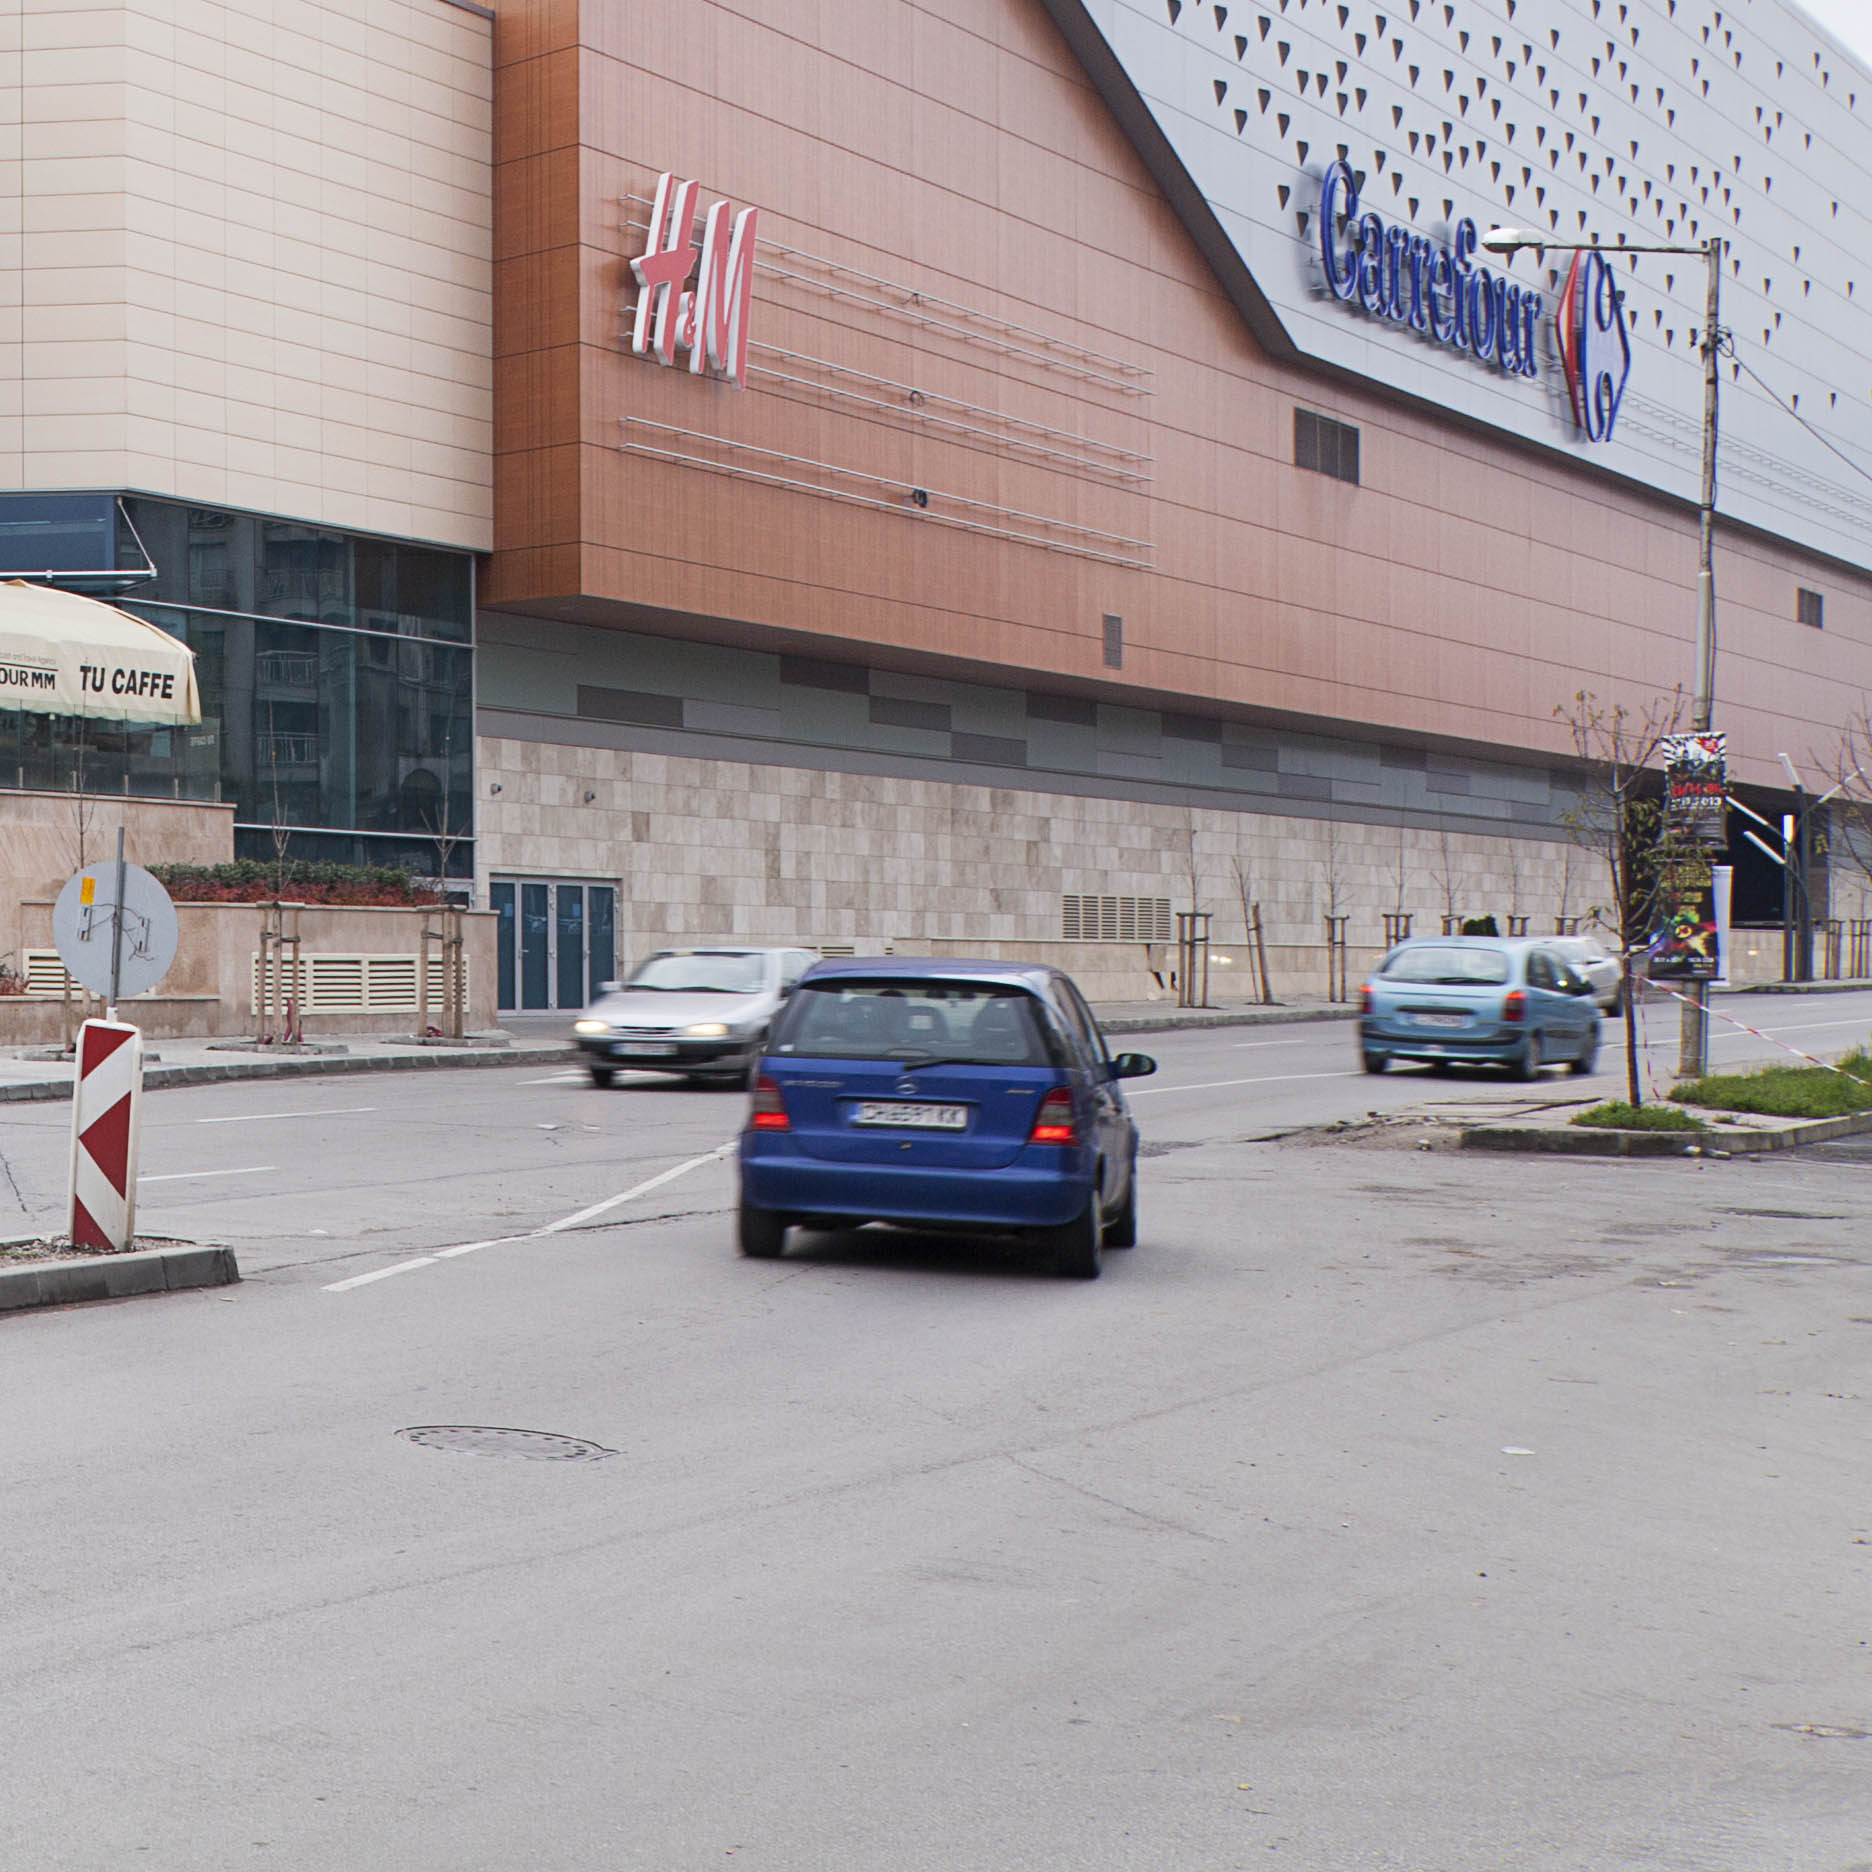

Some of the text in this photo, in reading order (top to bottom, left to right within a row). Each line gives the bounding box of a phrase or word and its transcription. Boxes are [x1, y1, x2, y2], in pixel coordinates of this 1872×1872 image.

[629, 171, 759, 391] H&M
[1319, 159, 1543, 379] Carrefour
[31, 670, 56, 691] MM
[79, 665, 175, 699] TU CAFFE
